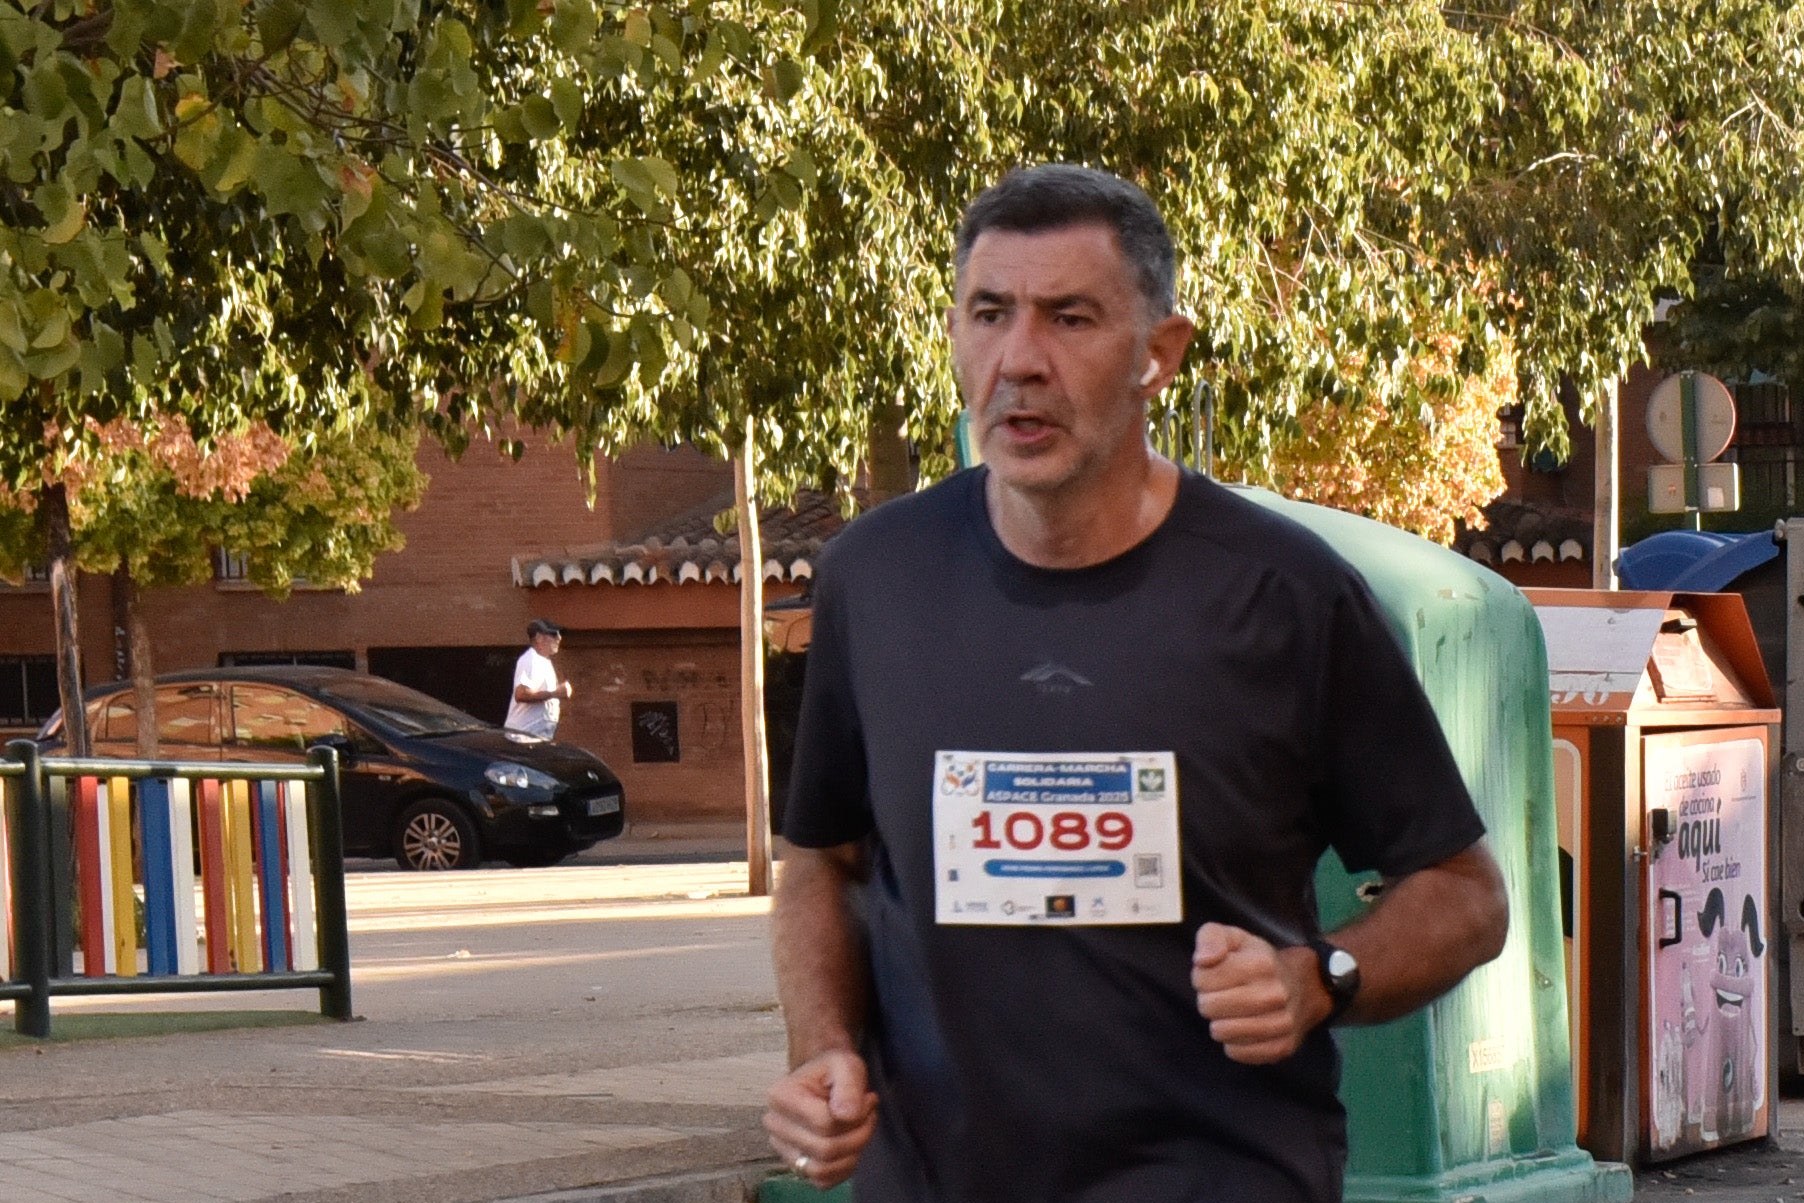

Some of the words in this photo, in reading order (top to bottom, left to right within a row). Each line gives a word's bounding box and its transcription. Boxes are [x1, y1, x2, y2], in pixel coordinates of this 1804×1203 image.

[1012, 777, 1094, 787] SOLIDARIA
[1697, 763, 1721, 788] usado
[986, 791, 1038, 801] ASPACE
[1040, 791, 1096, 802] Granada
[1680, 796, 1689, 816] de
[1690, 792, 1714, 814] cocina
[972, 811, 1134, 851] 1089
[1678, 797, 1721, 873] aquí
[1725, 857, 1741, 880] bien
